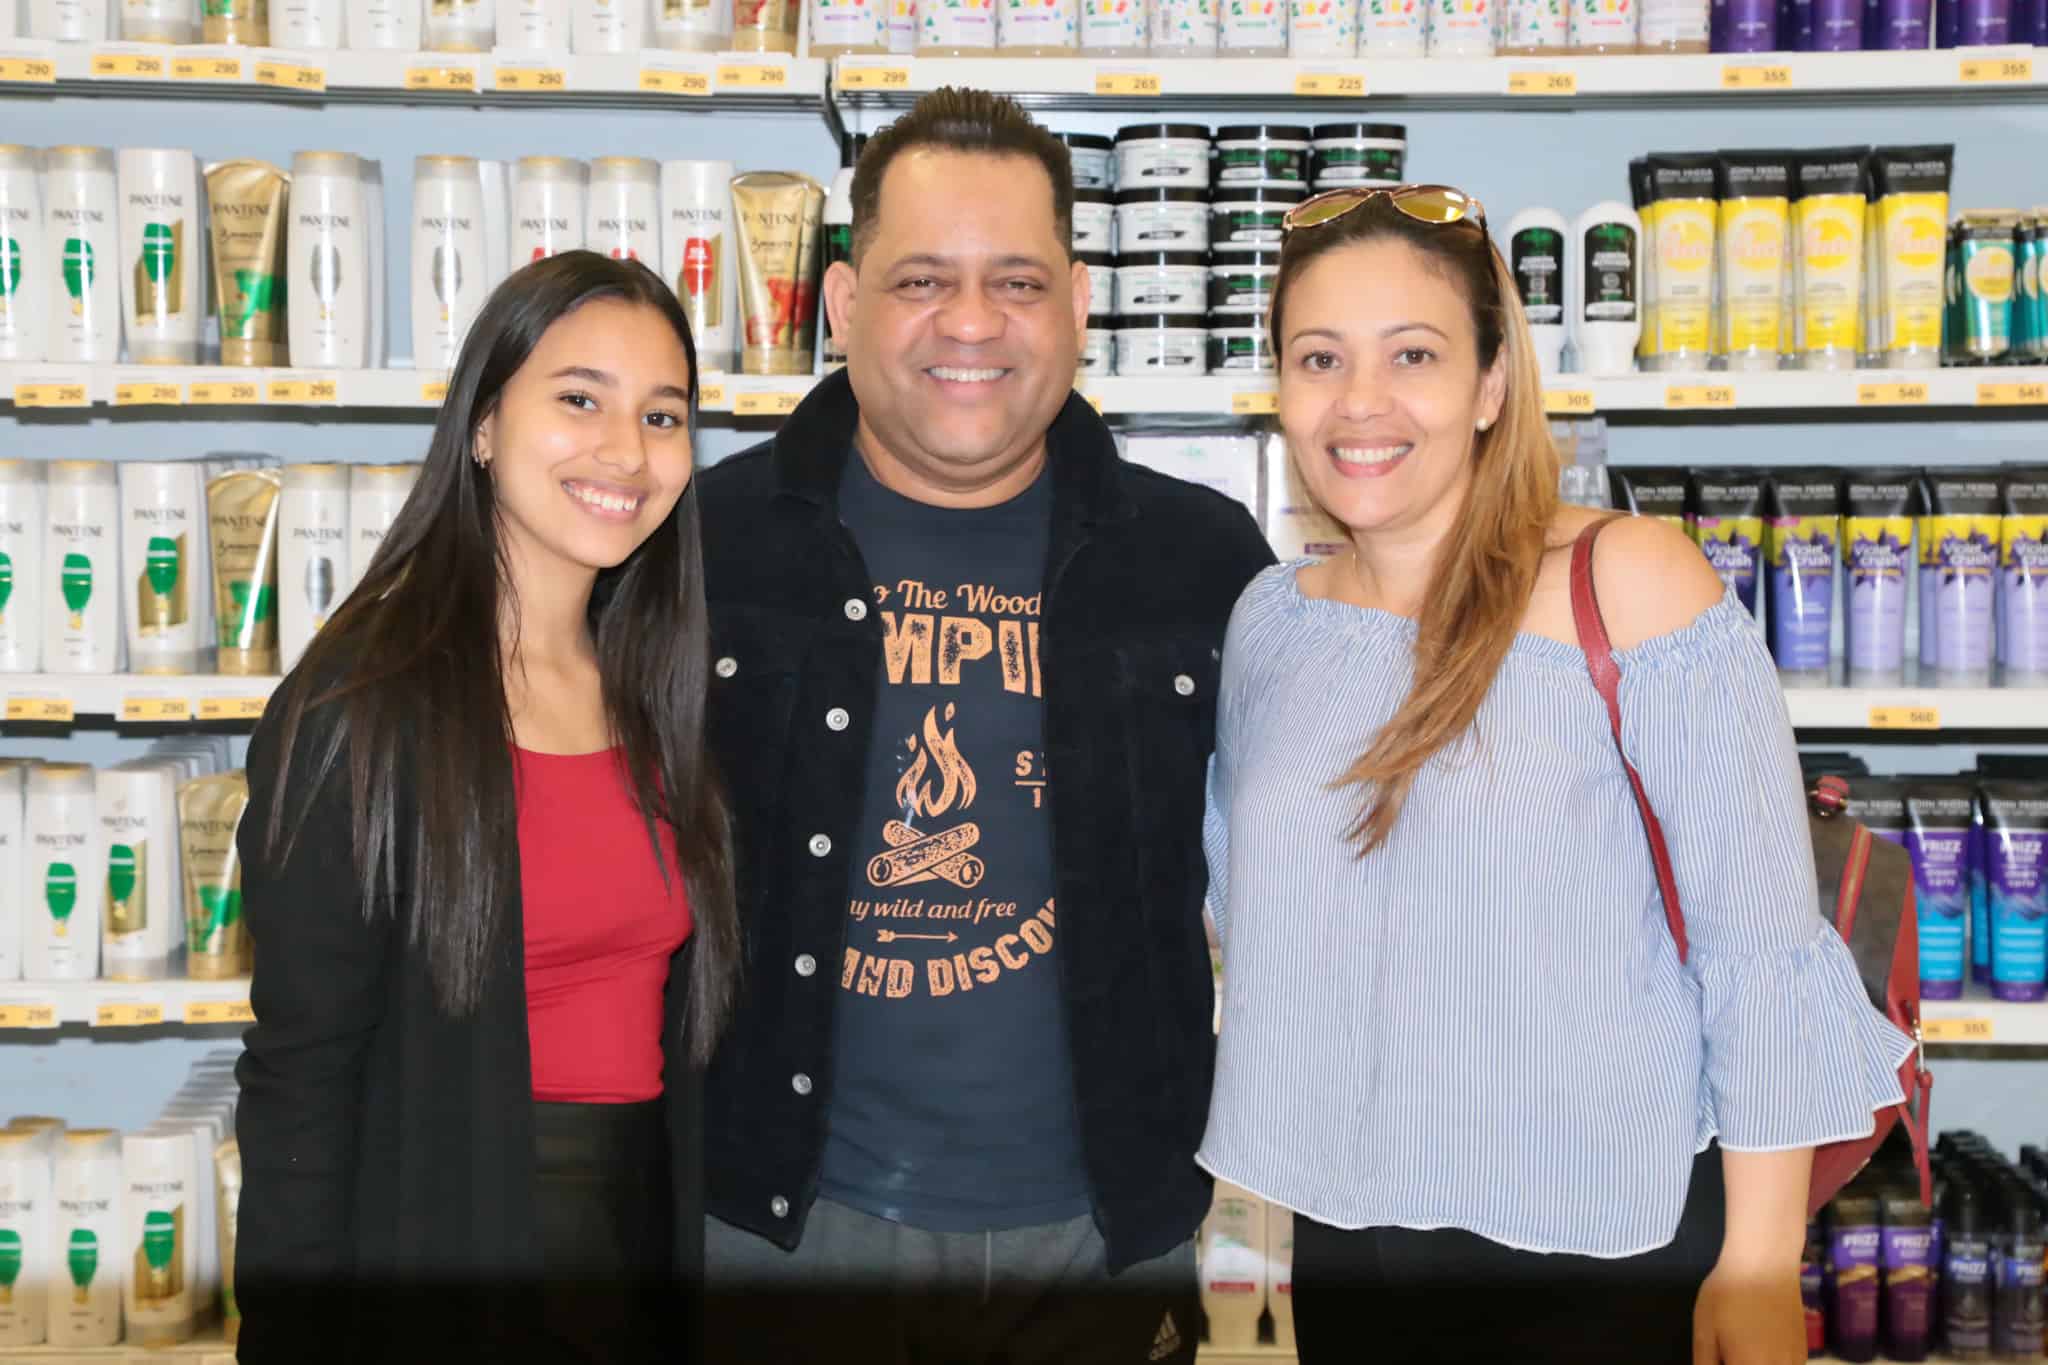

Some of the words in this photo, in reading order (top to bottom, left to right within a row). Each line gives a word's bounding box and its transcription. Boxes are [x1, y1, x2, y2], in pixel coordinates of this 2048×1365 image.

[299, 214, 350, 228] PANENE
[421, 217, 471, 231] PANENE
[520, 217, 568, 231] PANENE
[598, 218, 647, 231] PANENE
[1712, 555, 1752, 568] crush
[897, 579, 949, 609] The
[956, 583, 1042, 616] Wood
[874, 899, 923, 918] wild
[927, 902, 971, 920] and
[973, 899, 1017, 925] free
